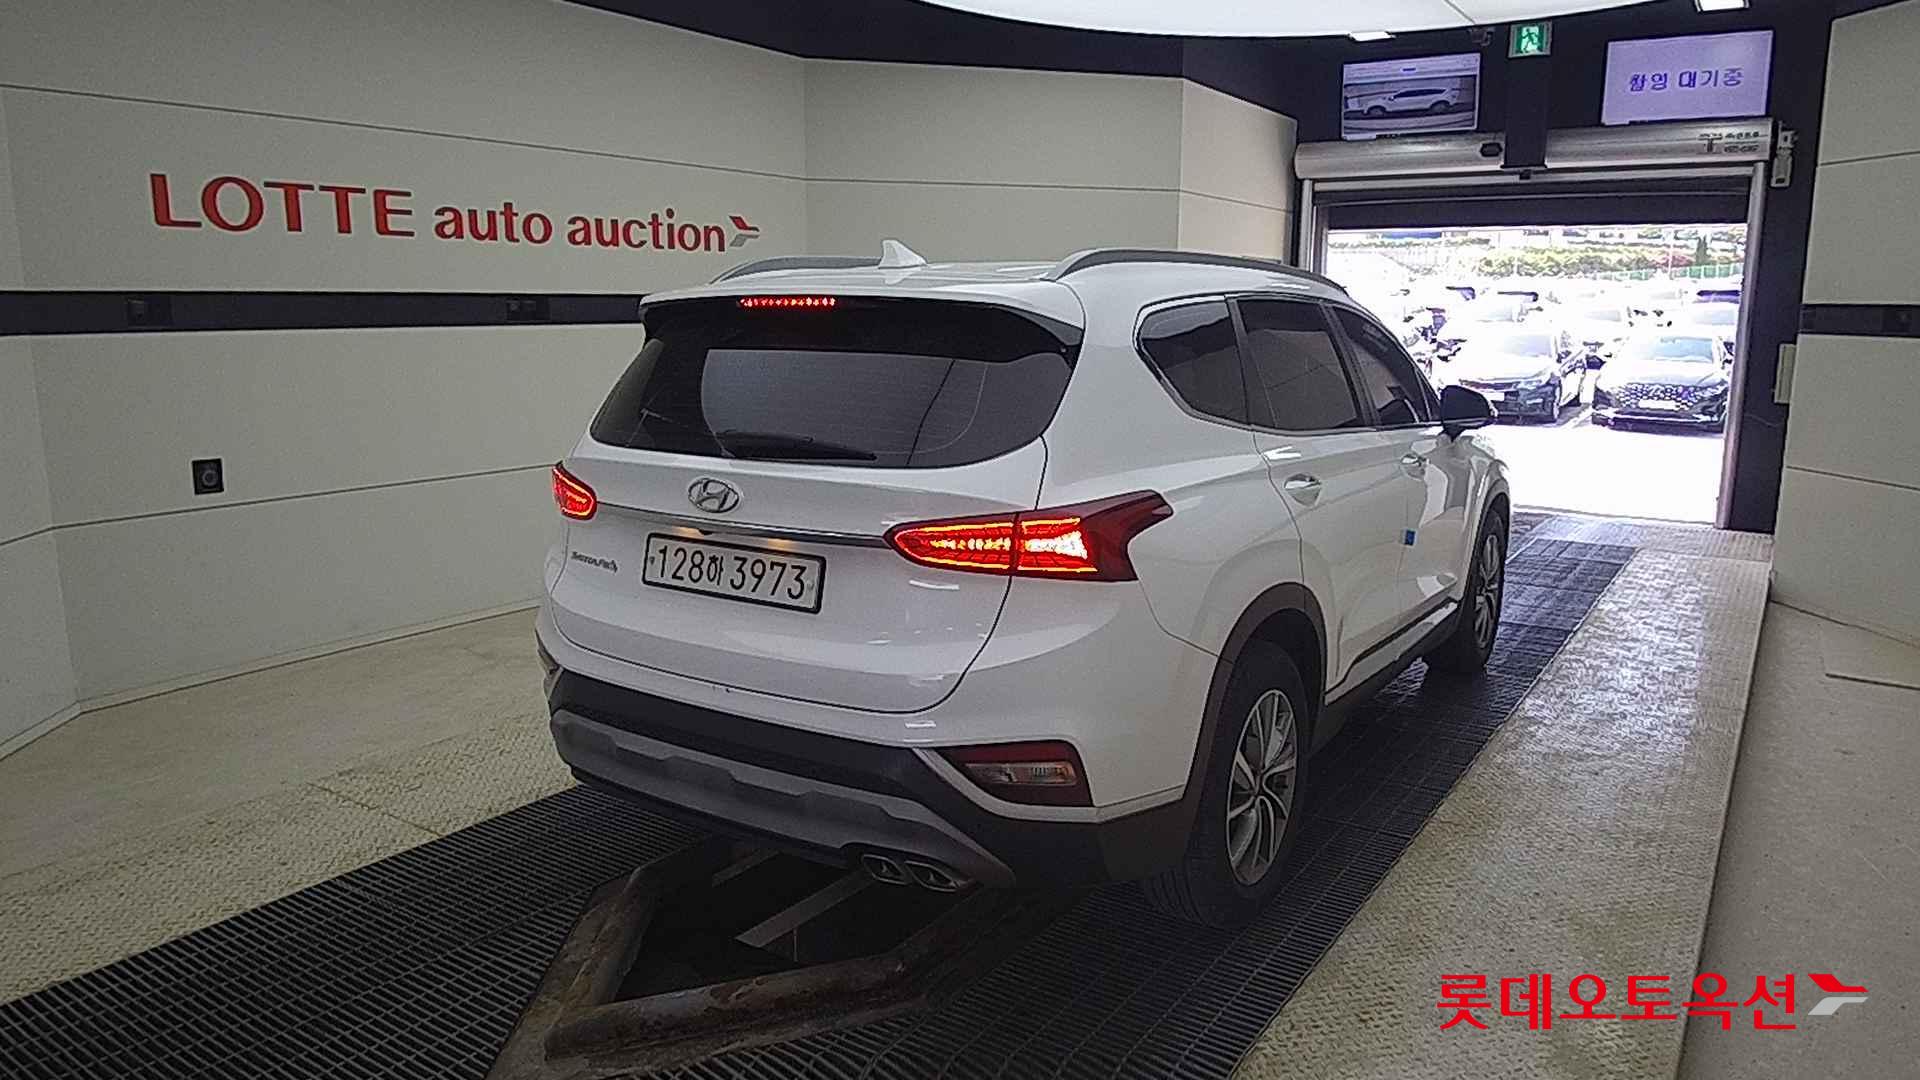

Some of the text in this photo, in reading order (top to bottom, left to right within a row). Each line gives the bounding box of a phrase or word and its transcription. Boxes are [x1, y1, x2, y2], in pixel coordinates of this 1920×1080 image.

[1678, 67, 1744, 88] 대기중
[150, 173, 725, 251] LOTTE auto auction
[729, 555, 807, 600] 3973
